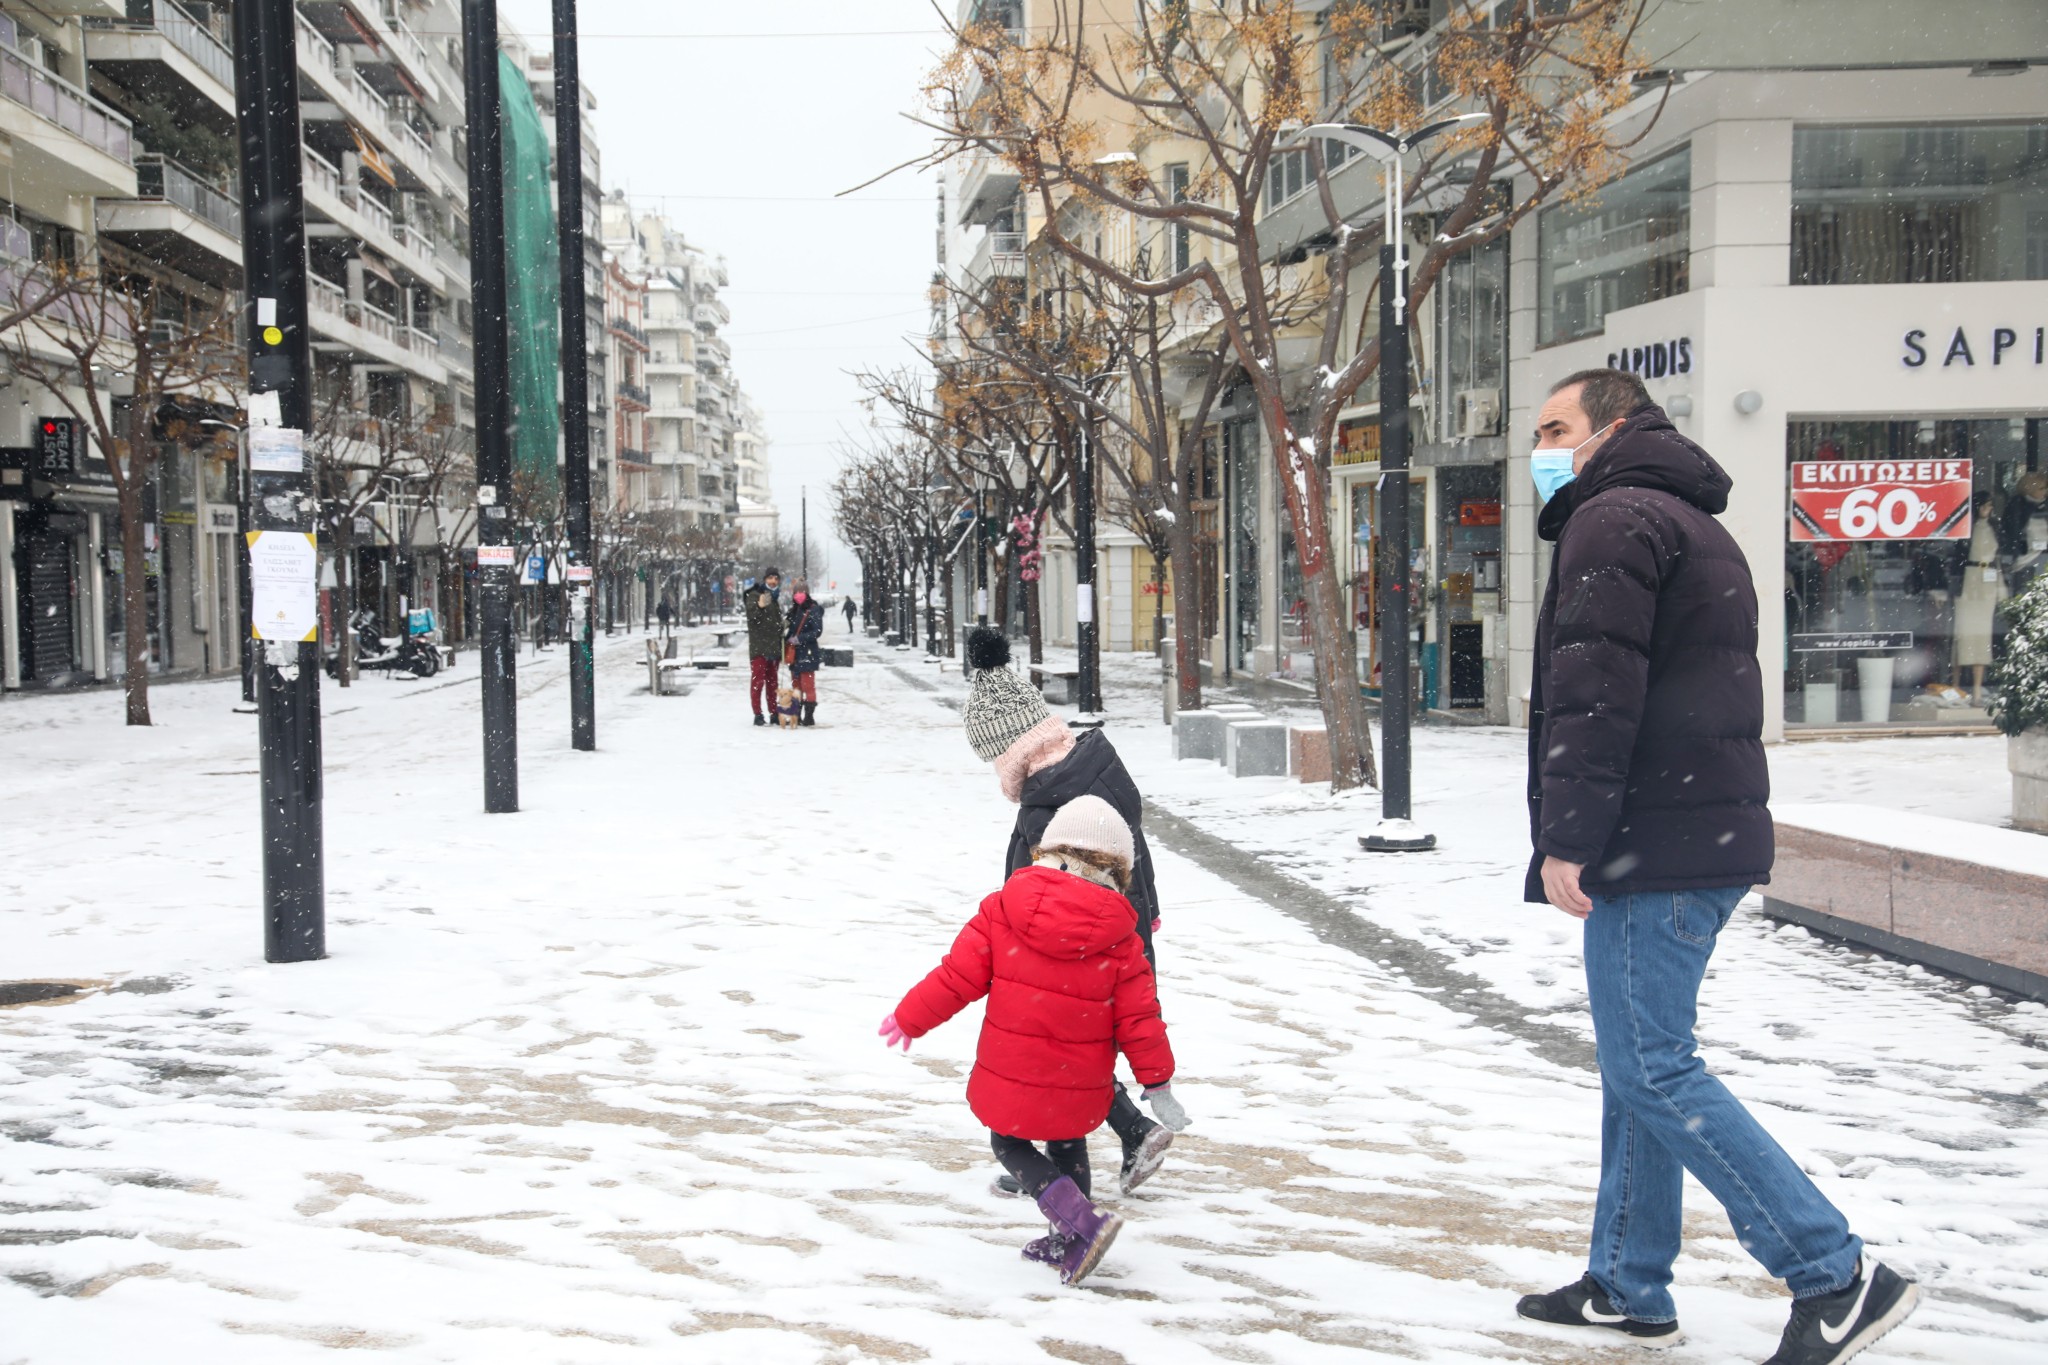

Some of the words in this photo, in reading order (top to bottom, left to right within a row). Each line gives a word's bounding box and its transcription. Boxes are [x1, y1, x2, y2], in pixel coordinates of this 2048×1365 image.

[1902, 326, 2044, 367] SAPI
[57, 422, 70, 469] CREAM
[1802, 462, 1961, 483] ΕΚΠΤΩΣΕΙΣ
